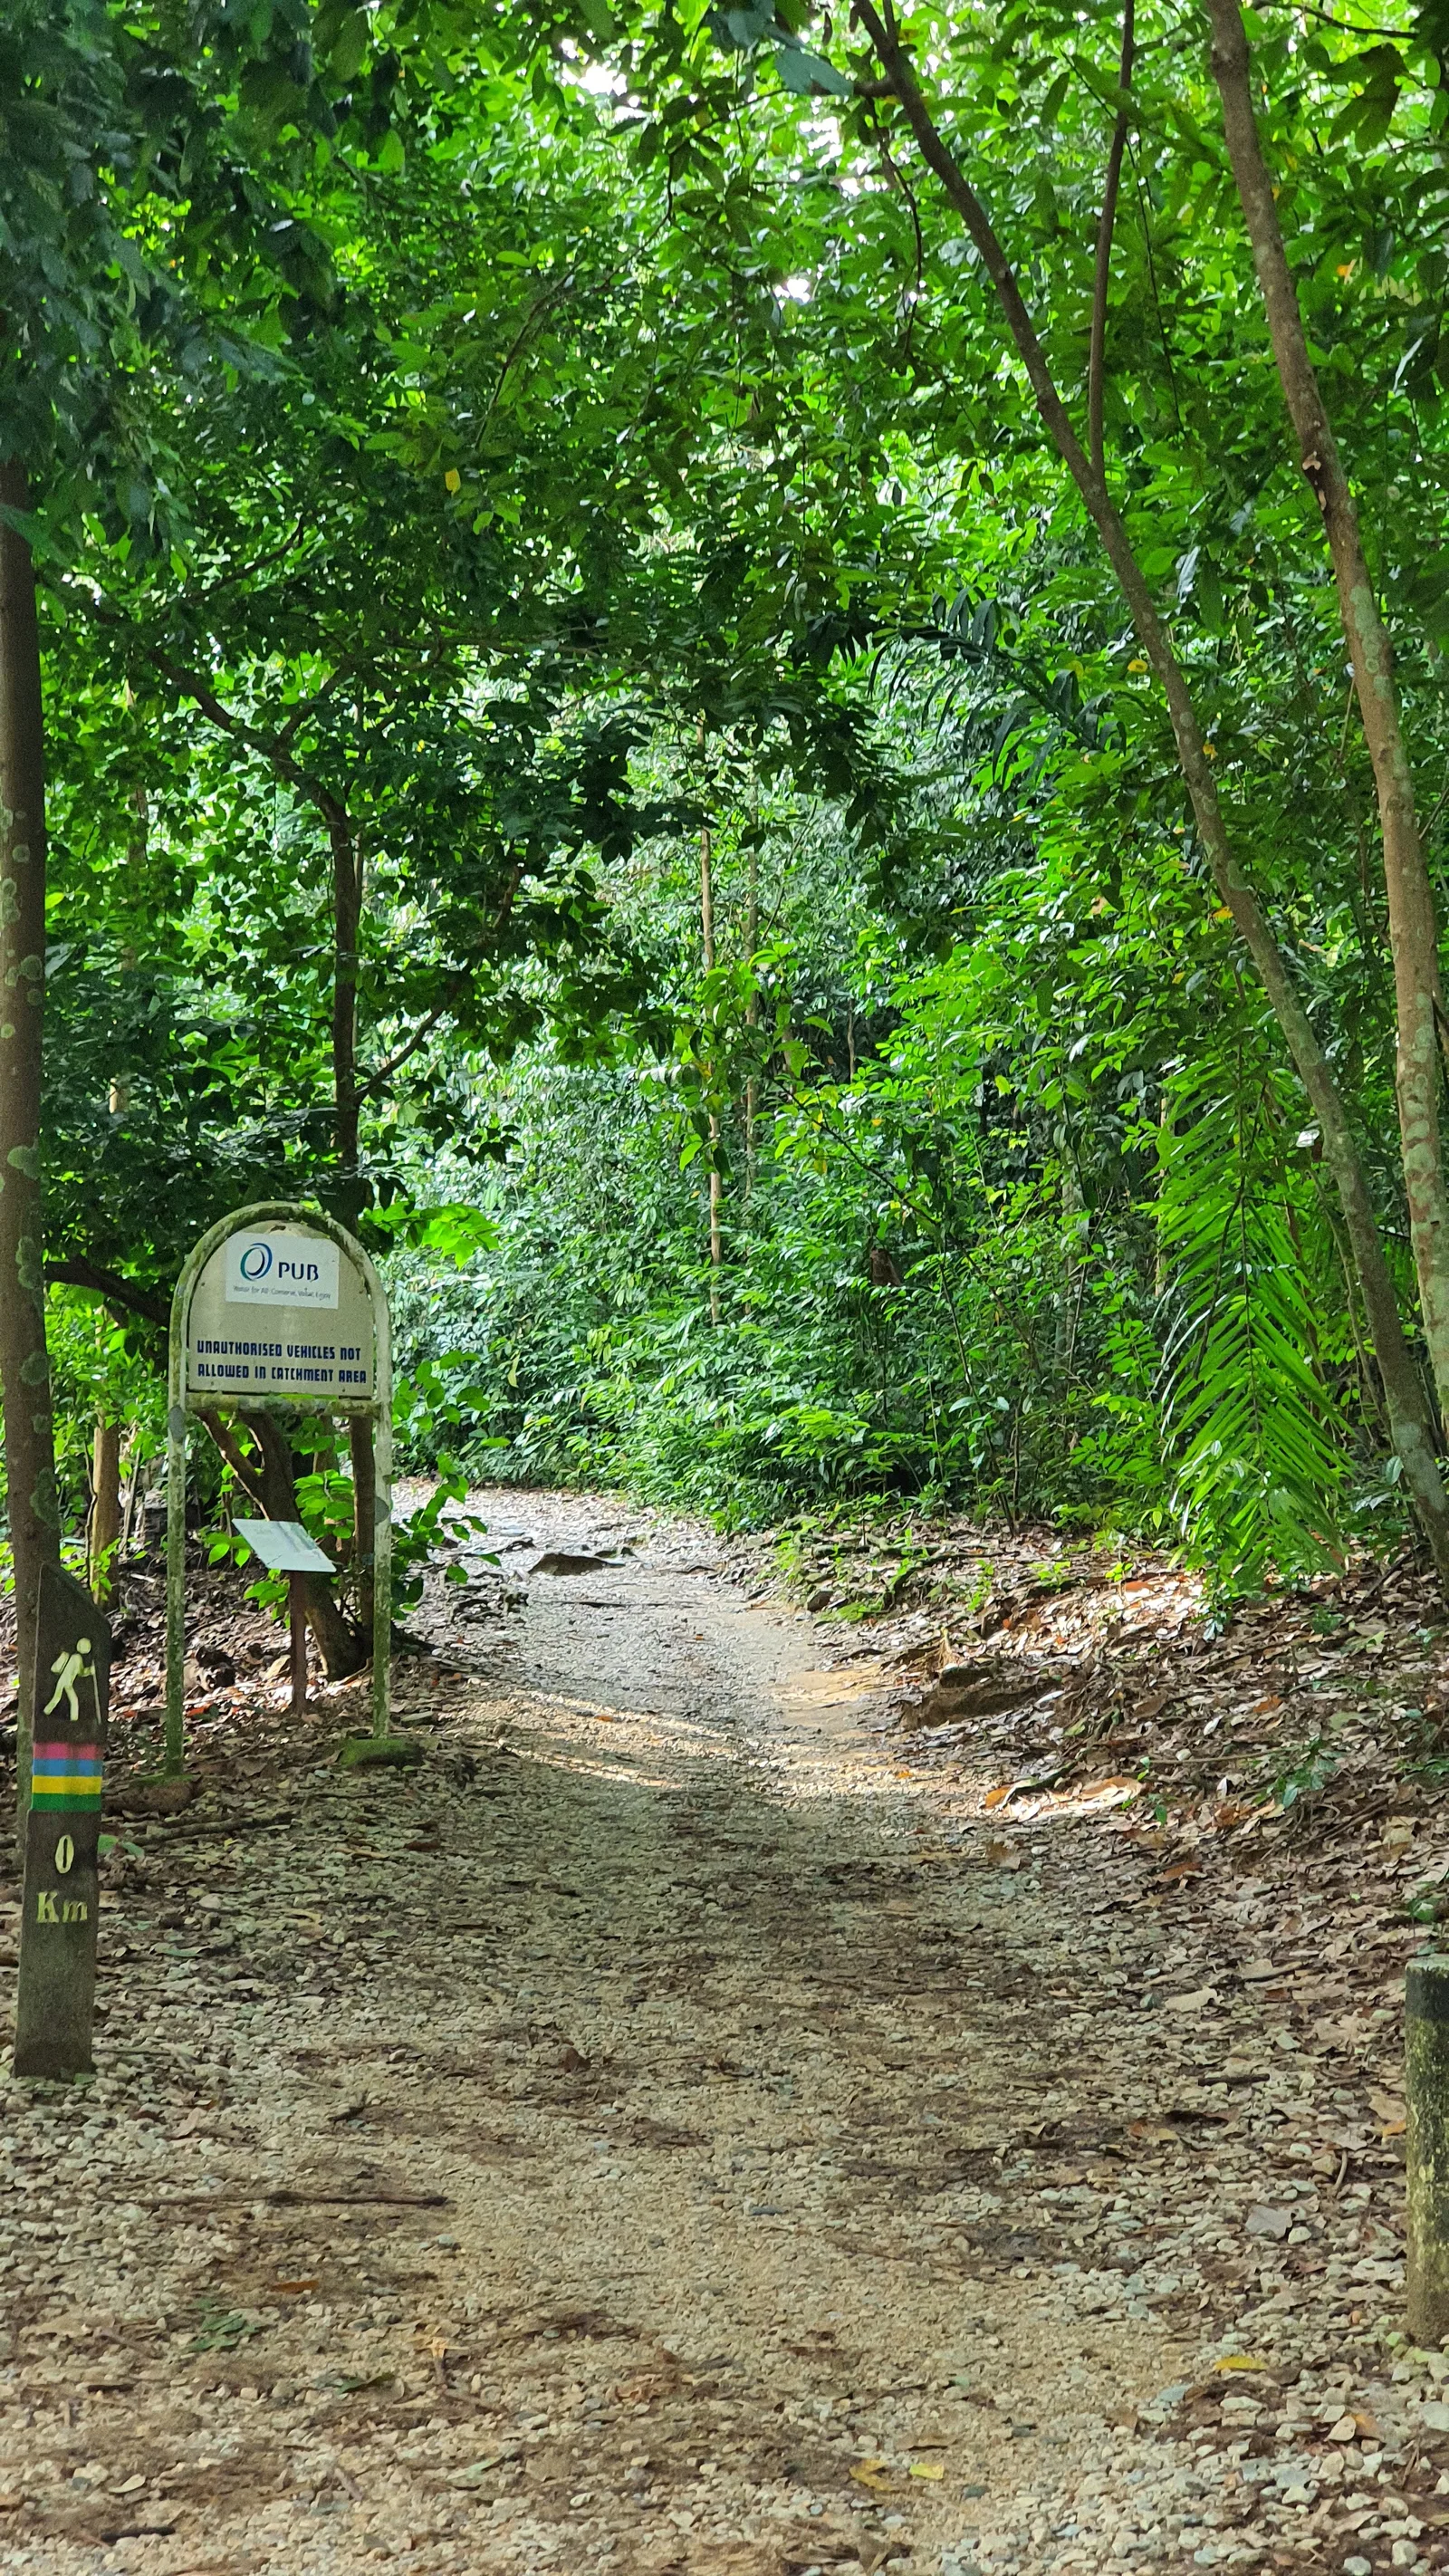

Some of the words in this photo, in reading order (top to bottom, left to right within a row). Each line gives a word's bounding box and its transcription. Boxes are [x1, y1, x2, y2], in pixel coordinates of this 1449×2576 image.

[278, 1261, 319, 1283] PUB
[197, 1340, 282, 1357] UNAUTHORISED
[287, 1344, 335, 1360] VEHICLES
[340, 1347, 361, 1360] NOT
[197, 1363, 249, 1379] ALLOWED
[254, 1366, 266, 1379] IN
[272, 1367, 333, 1382] CATCHMENT
[339, 1370, 367, 1384] AREA
[54, 1834, 74, 1874] 0
[37, 1890, 88, 1923] Km
